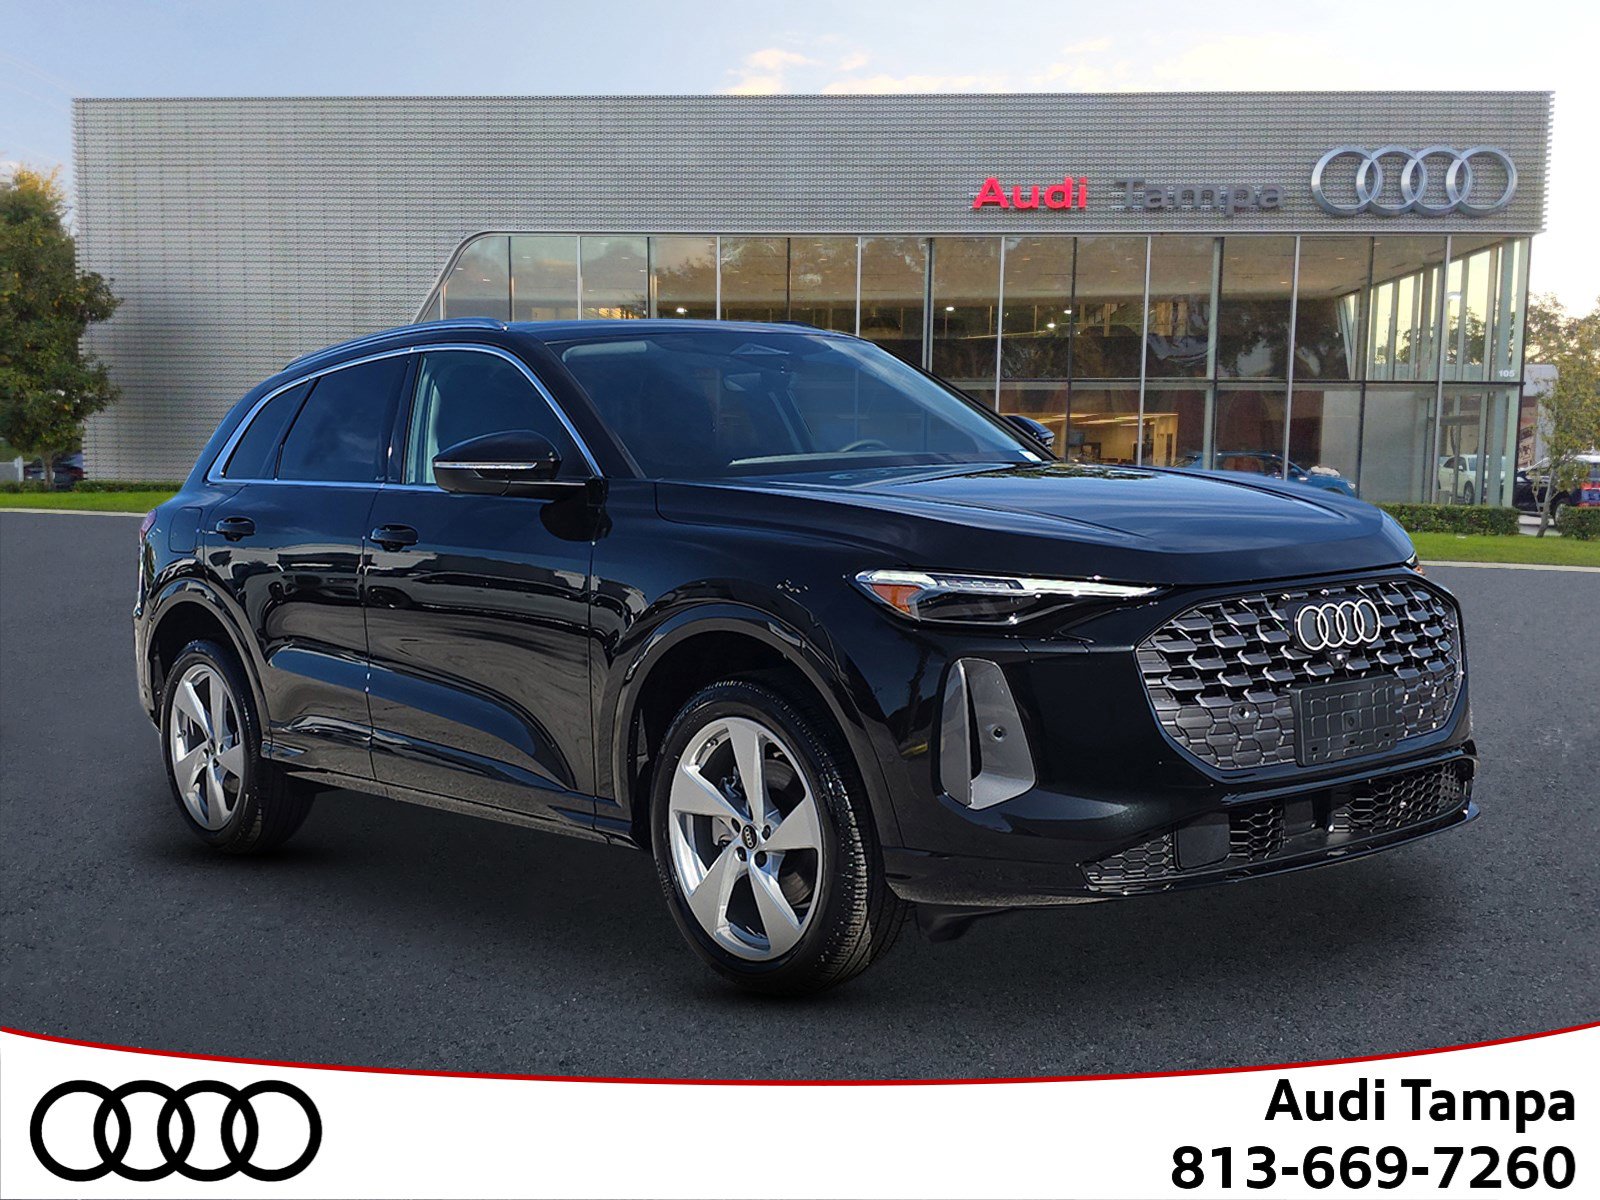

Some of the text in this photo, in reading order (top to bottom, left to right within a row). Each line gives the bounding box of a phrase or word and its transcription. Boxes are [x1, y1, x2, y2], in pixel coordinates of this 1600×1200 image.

[972, 176, 1285, 218] Audi Tampa
[1498, 369, 1515, 378] 105
